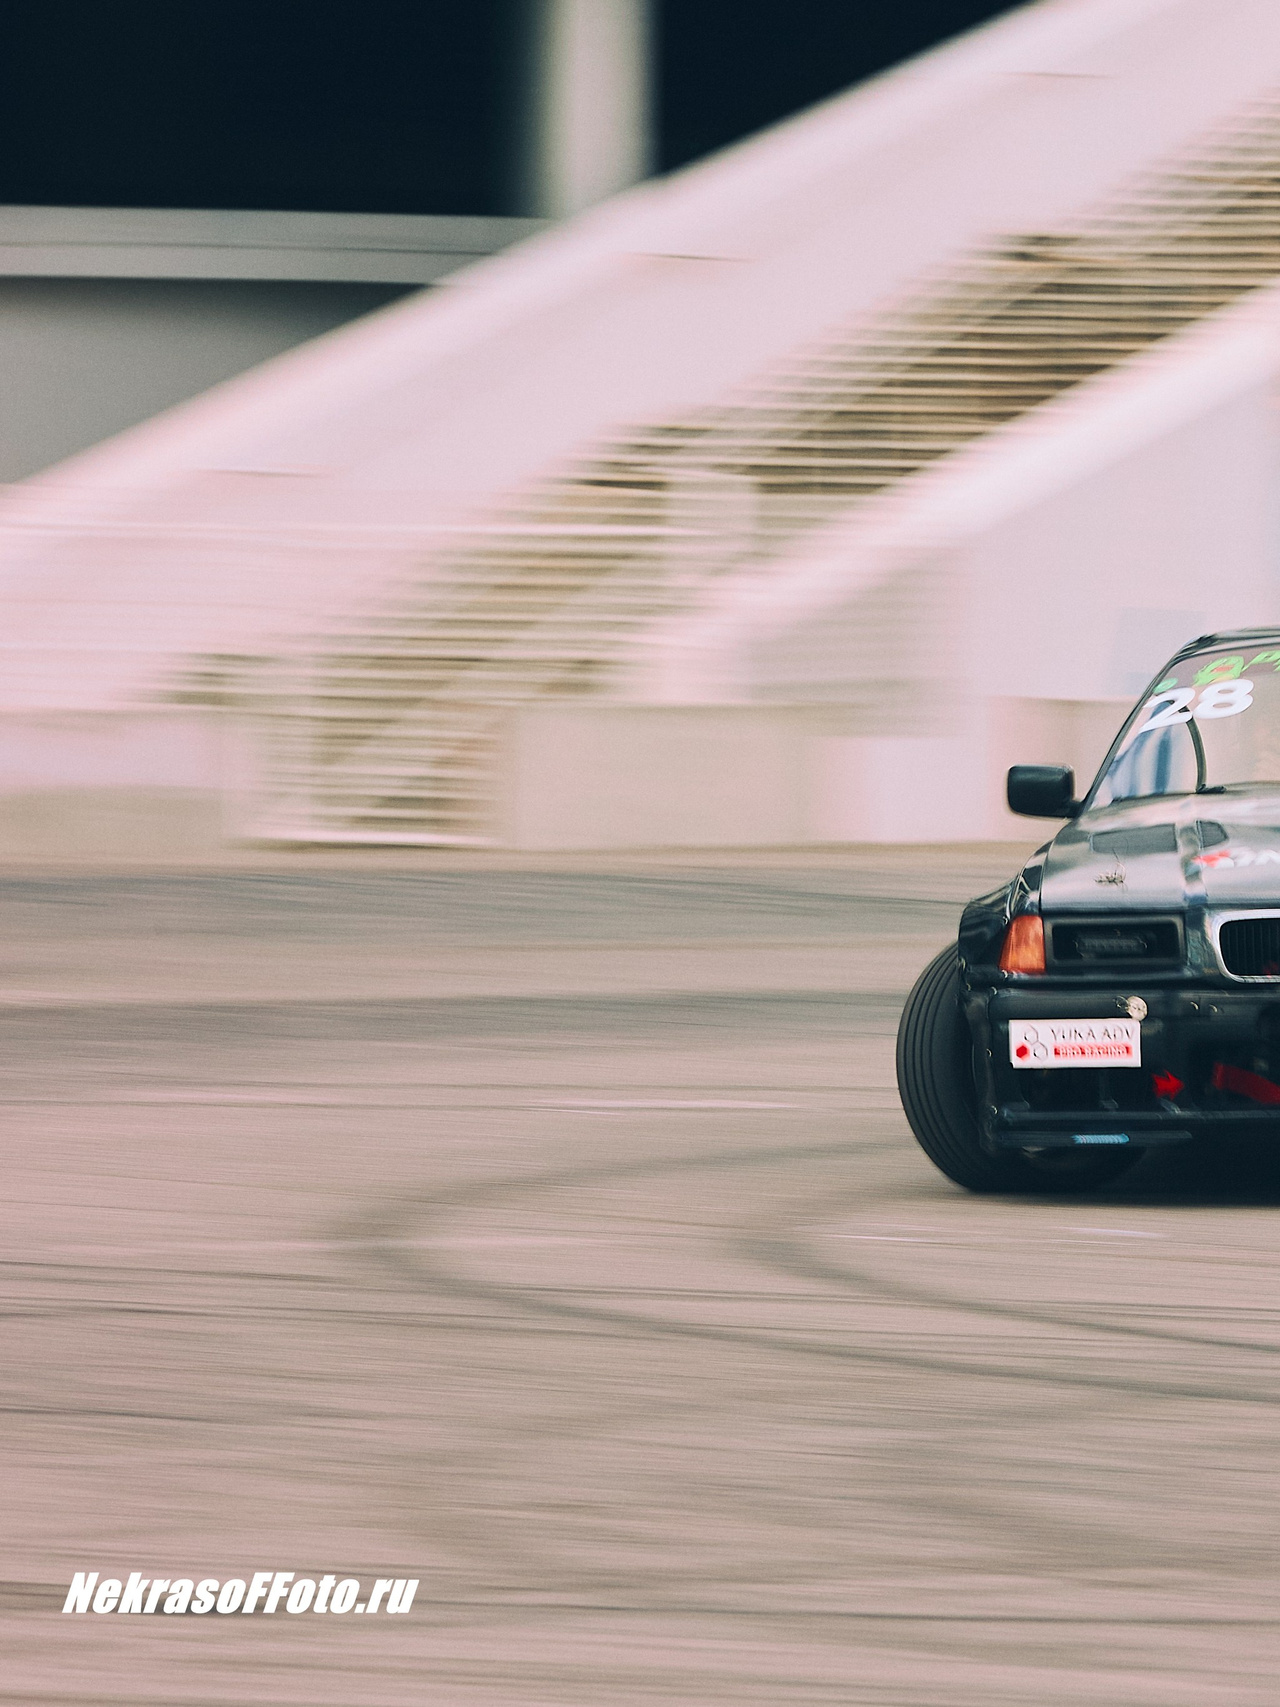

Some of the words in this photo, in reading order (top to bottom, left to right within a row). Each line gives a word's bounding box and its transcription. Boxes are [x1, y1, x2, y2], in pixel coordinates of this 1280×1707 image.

[1138, 678, 1254, 734] 28
[1050, 1025, 1097, 1041] YUKA
[1102, 1024, 1134, 1041] ADV
